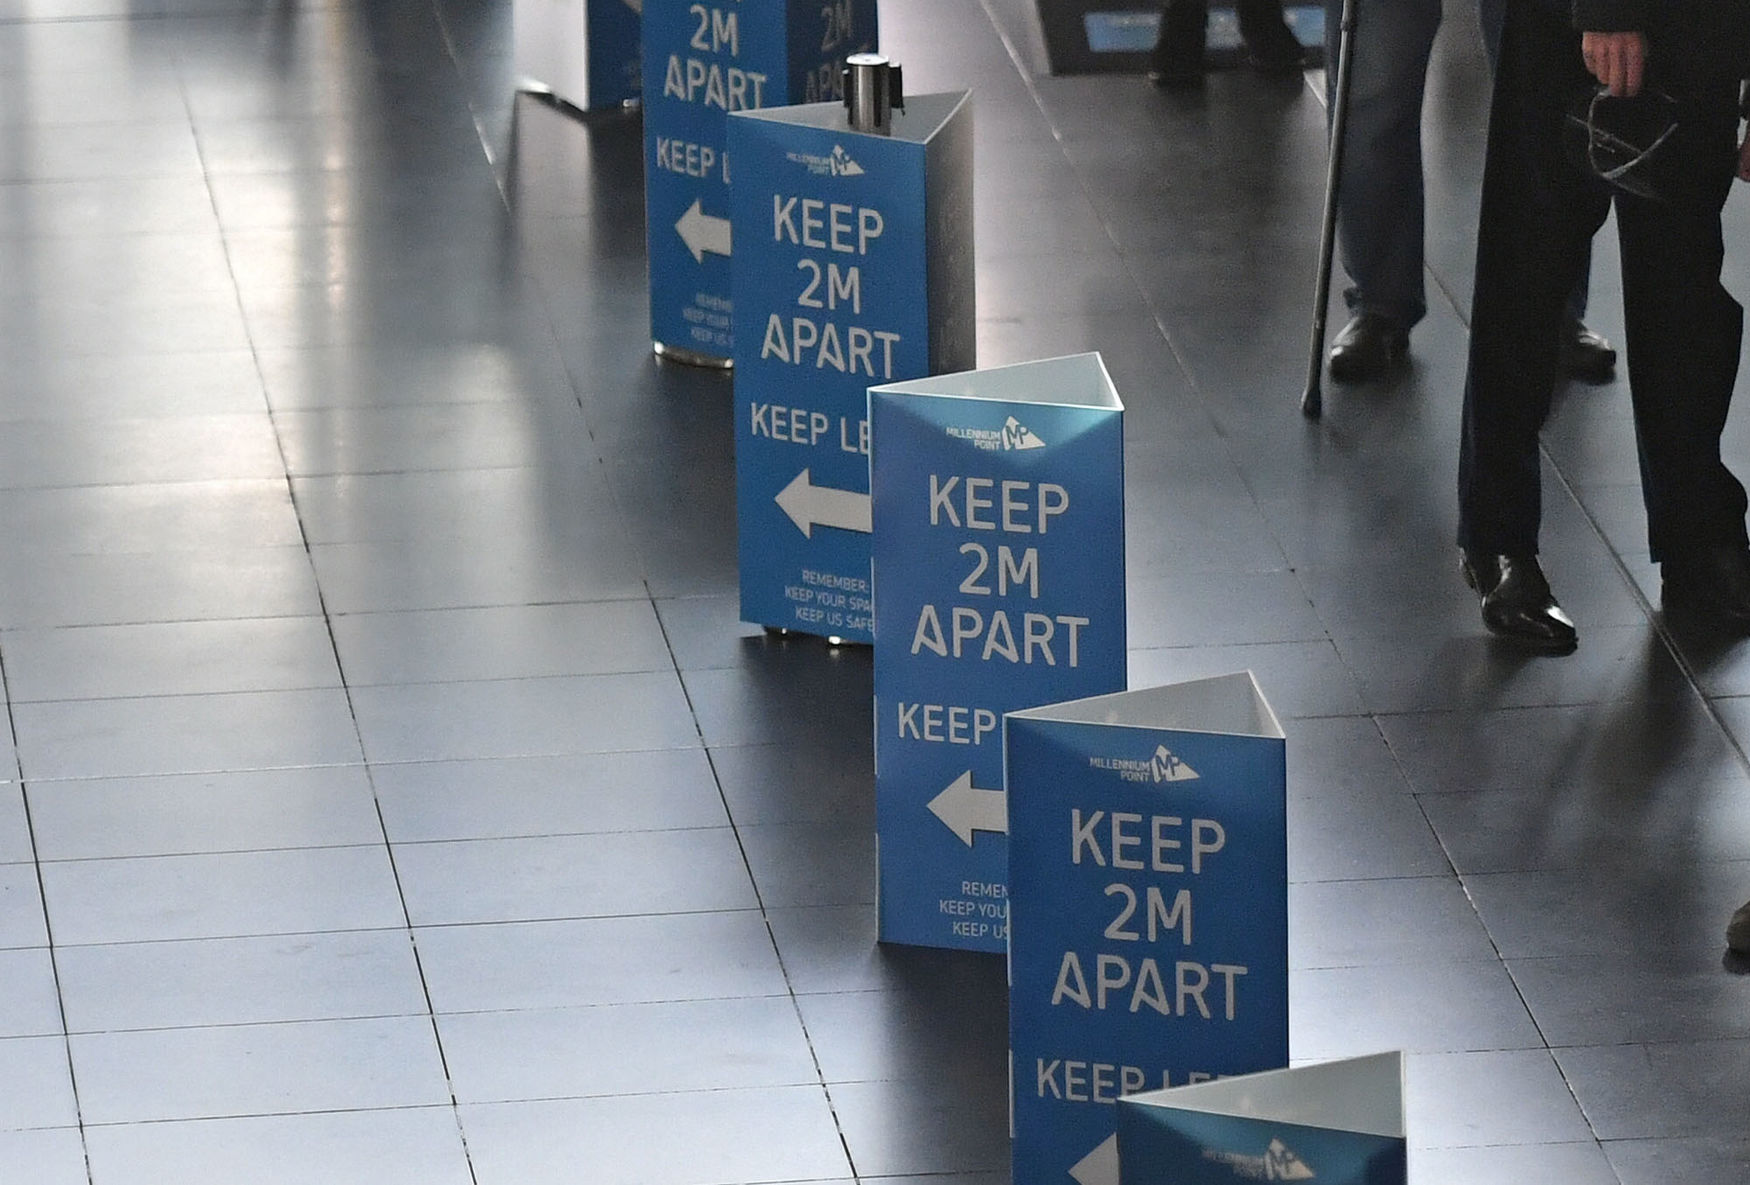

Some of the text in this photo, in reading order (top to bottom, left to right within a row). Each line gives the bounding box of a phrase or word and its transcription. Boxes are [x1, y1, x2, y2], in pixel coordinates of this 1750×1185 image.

[690, 4, 740, 57] 2M
[664, 55, 767, 111] APART
[657, 135, 715, 177] KEEP
[773, 194, 884, 256] KEEP
[797, 258, 861, 315] 2M
[760, 313, 901, 380] APART
[751, 401, 869, 455] KEEP LE
[930, 474, 1069, 534] KEEP
[959, 542, 1039, 599] 2M
[785, 585, 873, 613] KEEP YOUR SPA
[796, 605, 824, 623] KEEP
[827, 612, 843, 627] US
[911, 604, 1090, 667] APART
[898, 702, 997, 745] KEEP
[1089, 757, 1151, 773] MILLENNIUM
[1120, 770, 1151, 783] POINT
[1071, 808, 1226, 874] KEEP
[939, 899, 1007, 919] KEEP YOU
[952, 921, 988, 937] KEEP
[1104, 883, 1192, 946] 2M
[1051, 950, 1249, 1021] APART
[1036, 1058, 1146, 1105] KEEP
